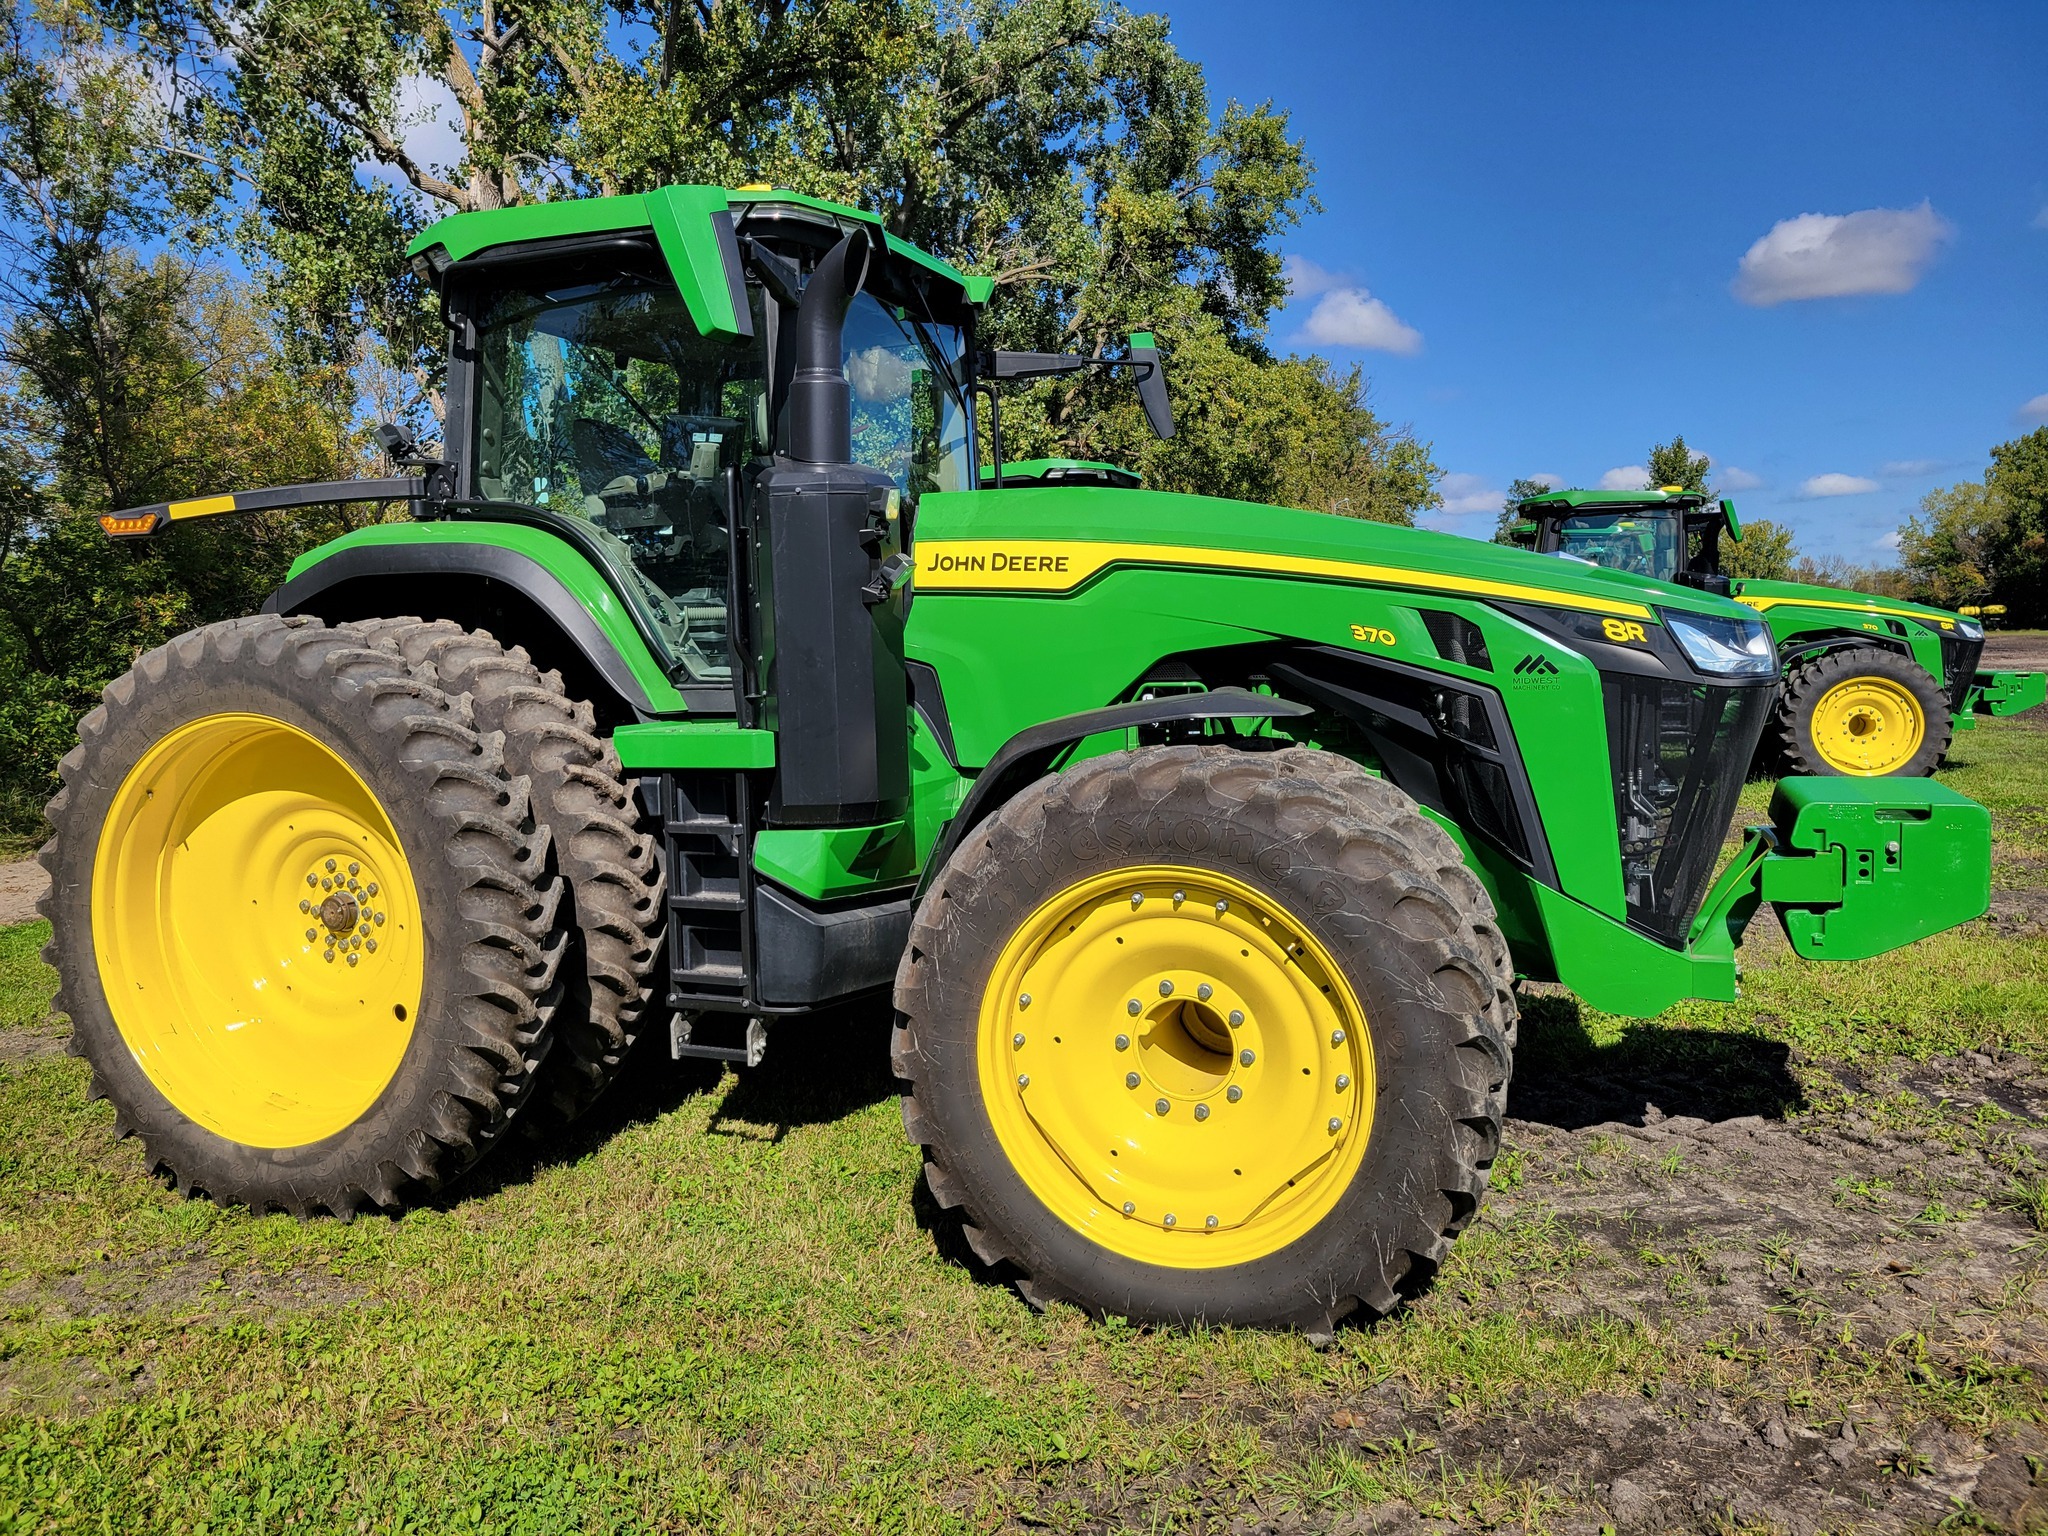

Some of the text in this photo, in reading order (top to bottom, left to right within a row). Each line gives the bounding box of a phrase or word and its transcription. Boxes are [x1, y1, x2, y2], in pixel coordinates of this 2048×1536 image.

[927, 553, 1069, 572] JOHN DEERE
[1349, 624, 1397, 646] 370
[1601, 618, 1648, 643] 8R
[1862, 623, 1879, 631] 370
[1940, 621, 1954, 631] 8R
[1512, 677, 1560, 685] MIDWEST
[990, 815, 1293, 911] Firestone
